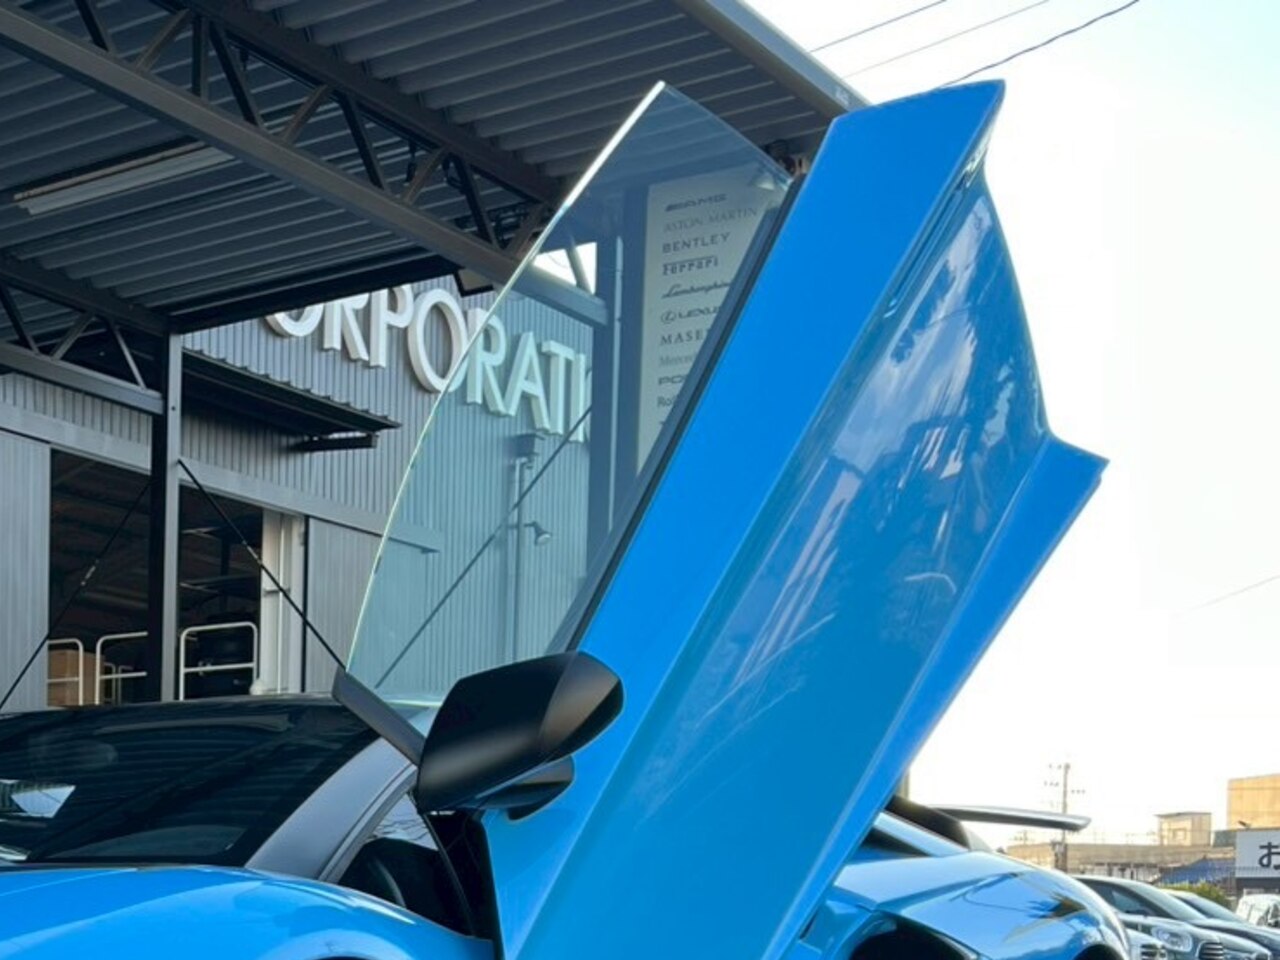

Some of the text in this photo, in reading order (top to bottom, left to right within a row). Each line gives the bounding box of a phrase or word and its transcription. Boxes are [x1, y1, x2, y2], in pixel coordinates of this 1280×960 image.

[662, 231, 731, 254] BENTLEY
[678, 305, 721, 319] LEXU
[660, 328, 709, 346] MASE
[265, 284, 592, 443] RPORATI
[1258, 841, 1280, 871] お
